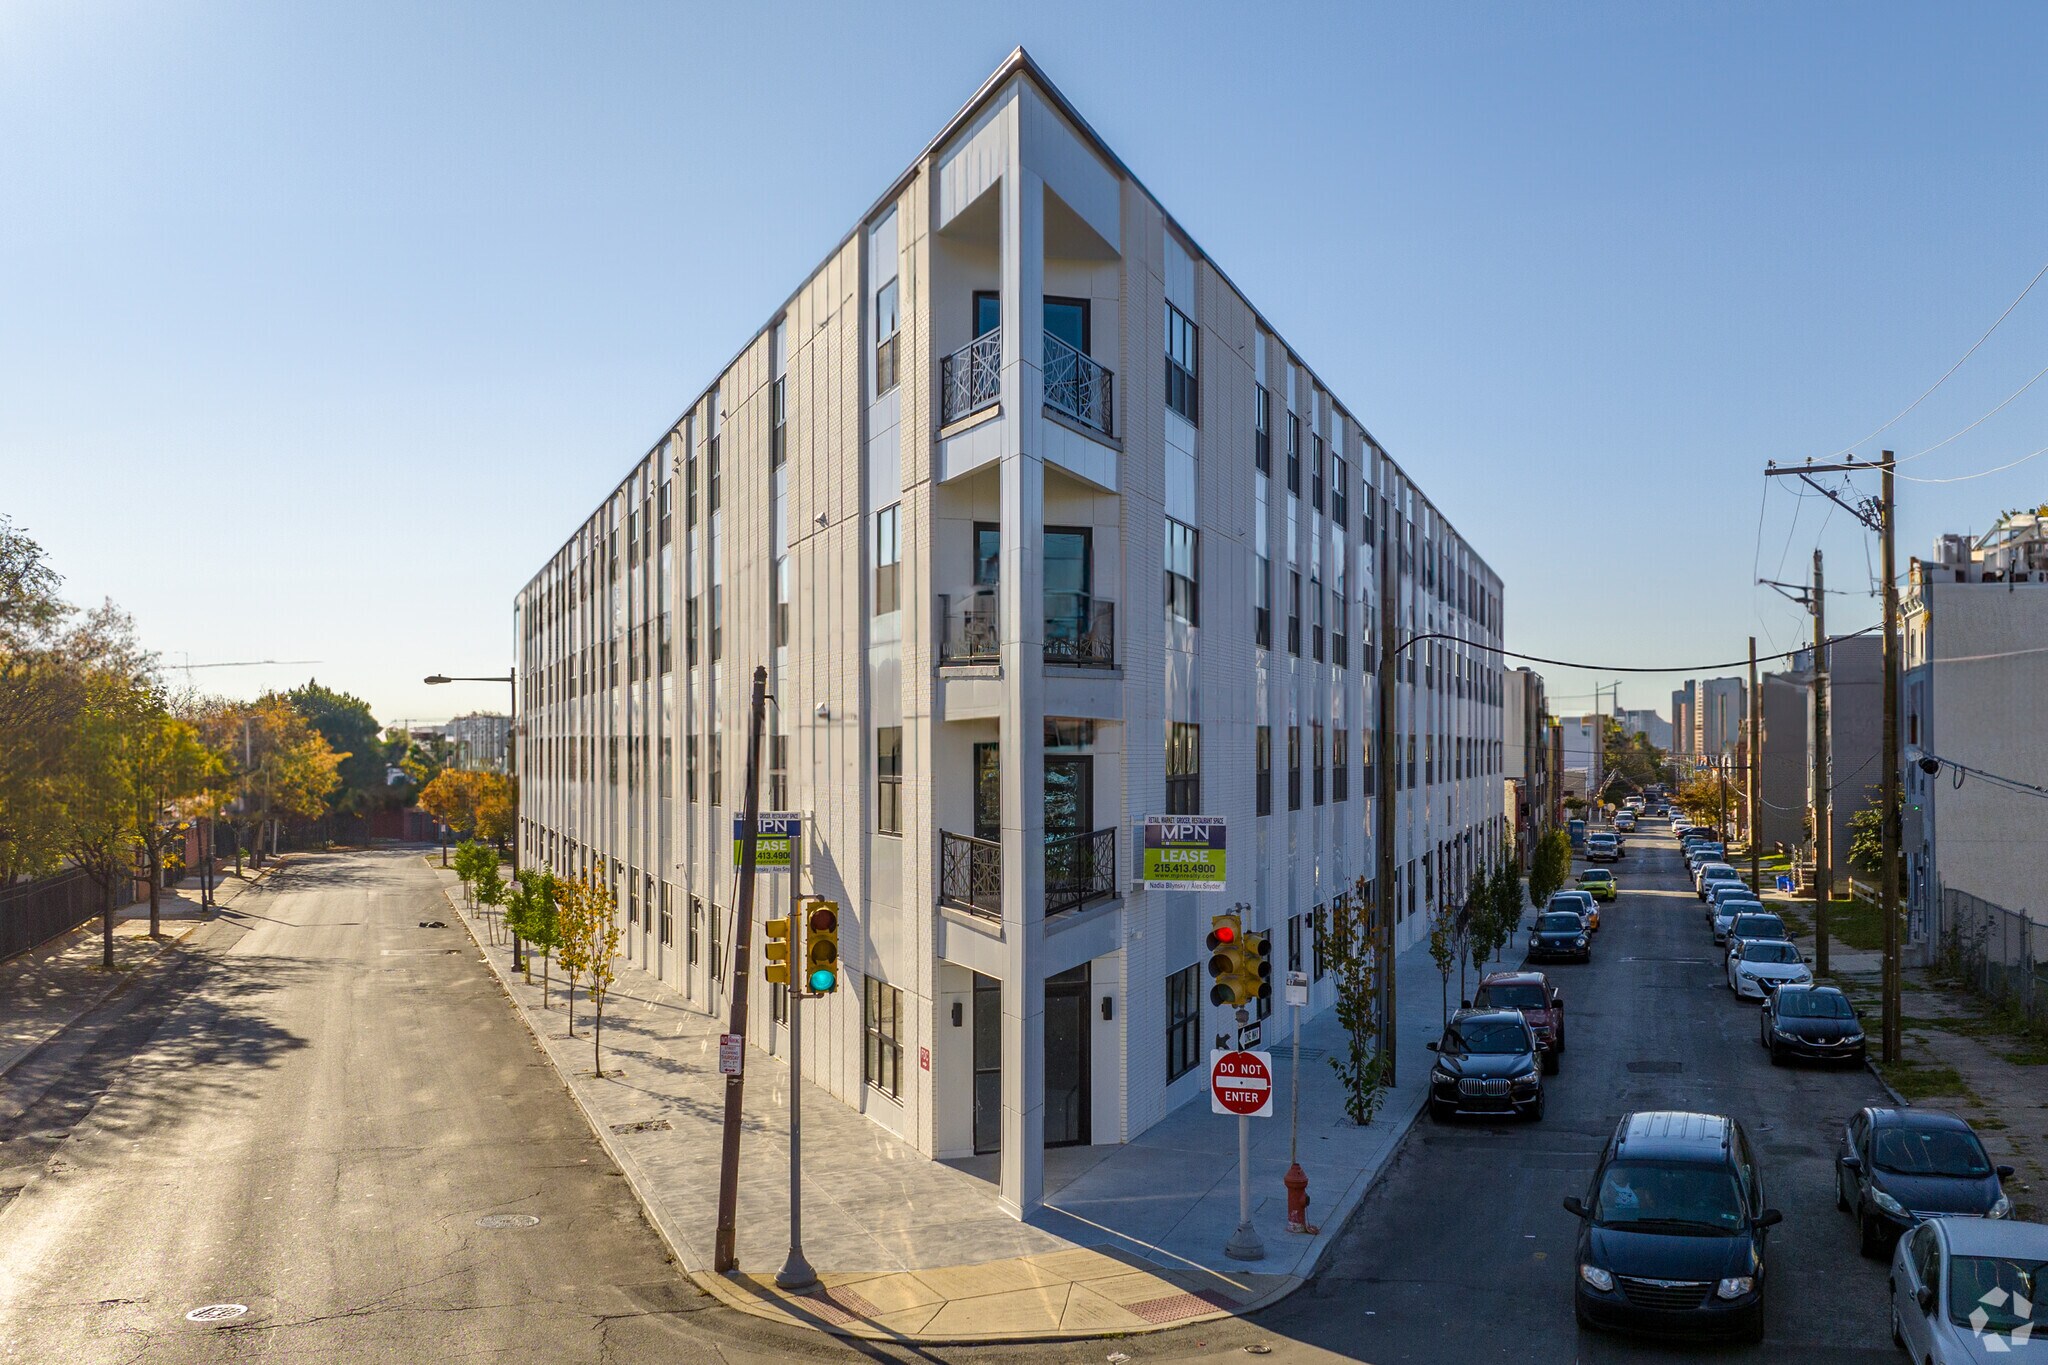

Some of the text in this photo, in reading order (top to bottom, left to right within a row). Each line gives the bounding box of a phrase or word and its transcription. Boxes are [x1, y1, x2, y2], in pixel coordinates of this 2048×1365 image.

[758, 820, 787, 832] PN
[1161, 825, 1209, 840] MPN
[756, 840, 787, 851] EASE
[1160, 850, 1209, 863] LEASE
[1153, 863, 1216, 873] 215.413.4900
[1202, 882, 1221, 890] Snyder
[1220, 1063, 1262, 1075] DO NOT
[1225, 1091, 1259, 1103] ENTER
